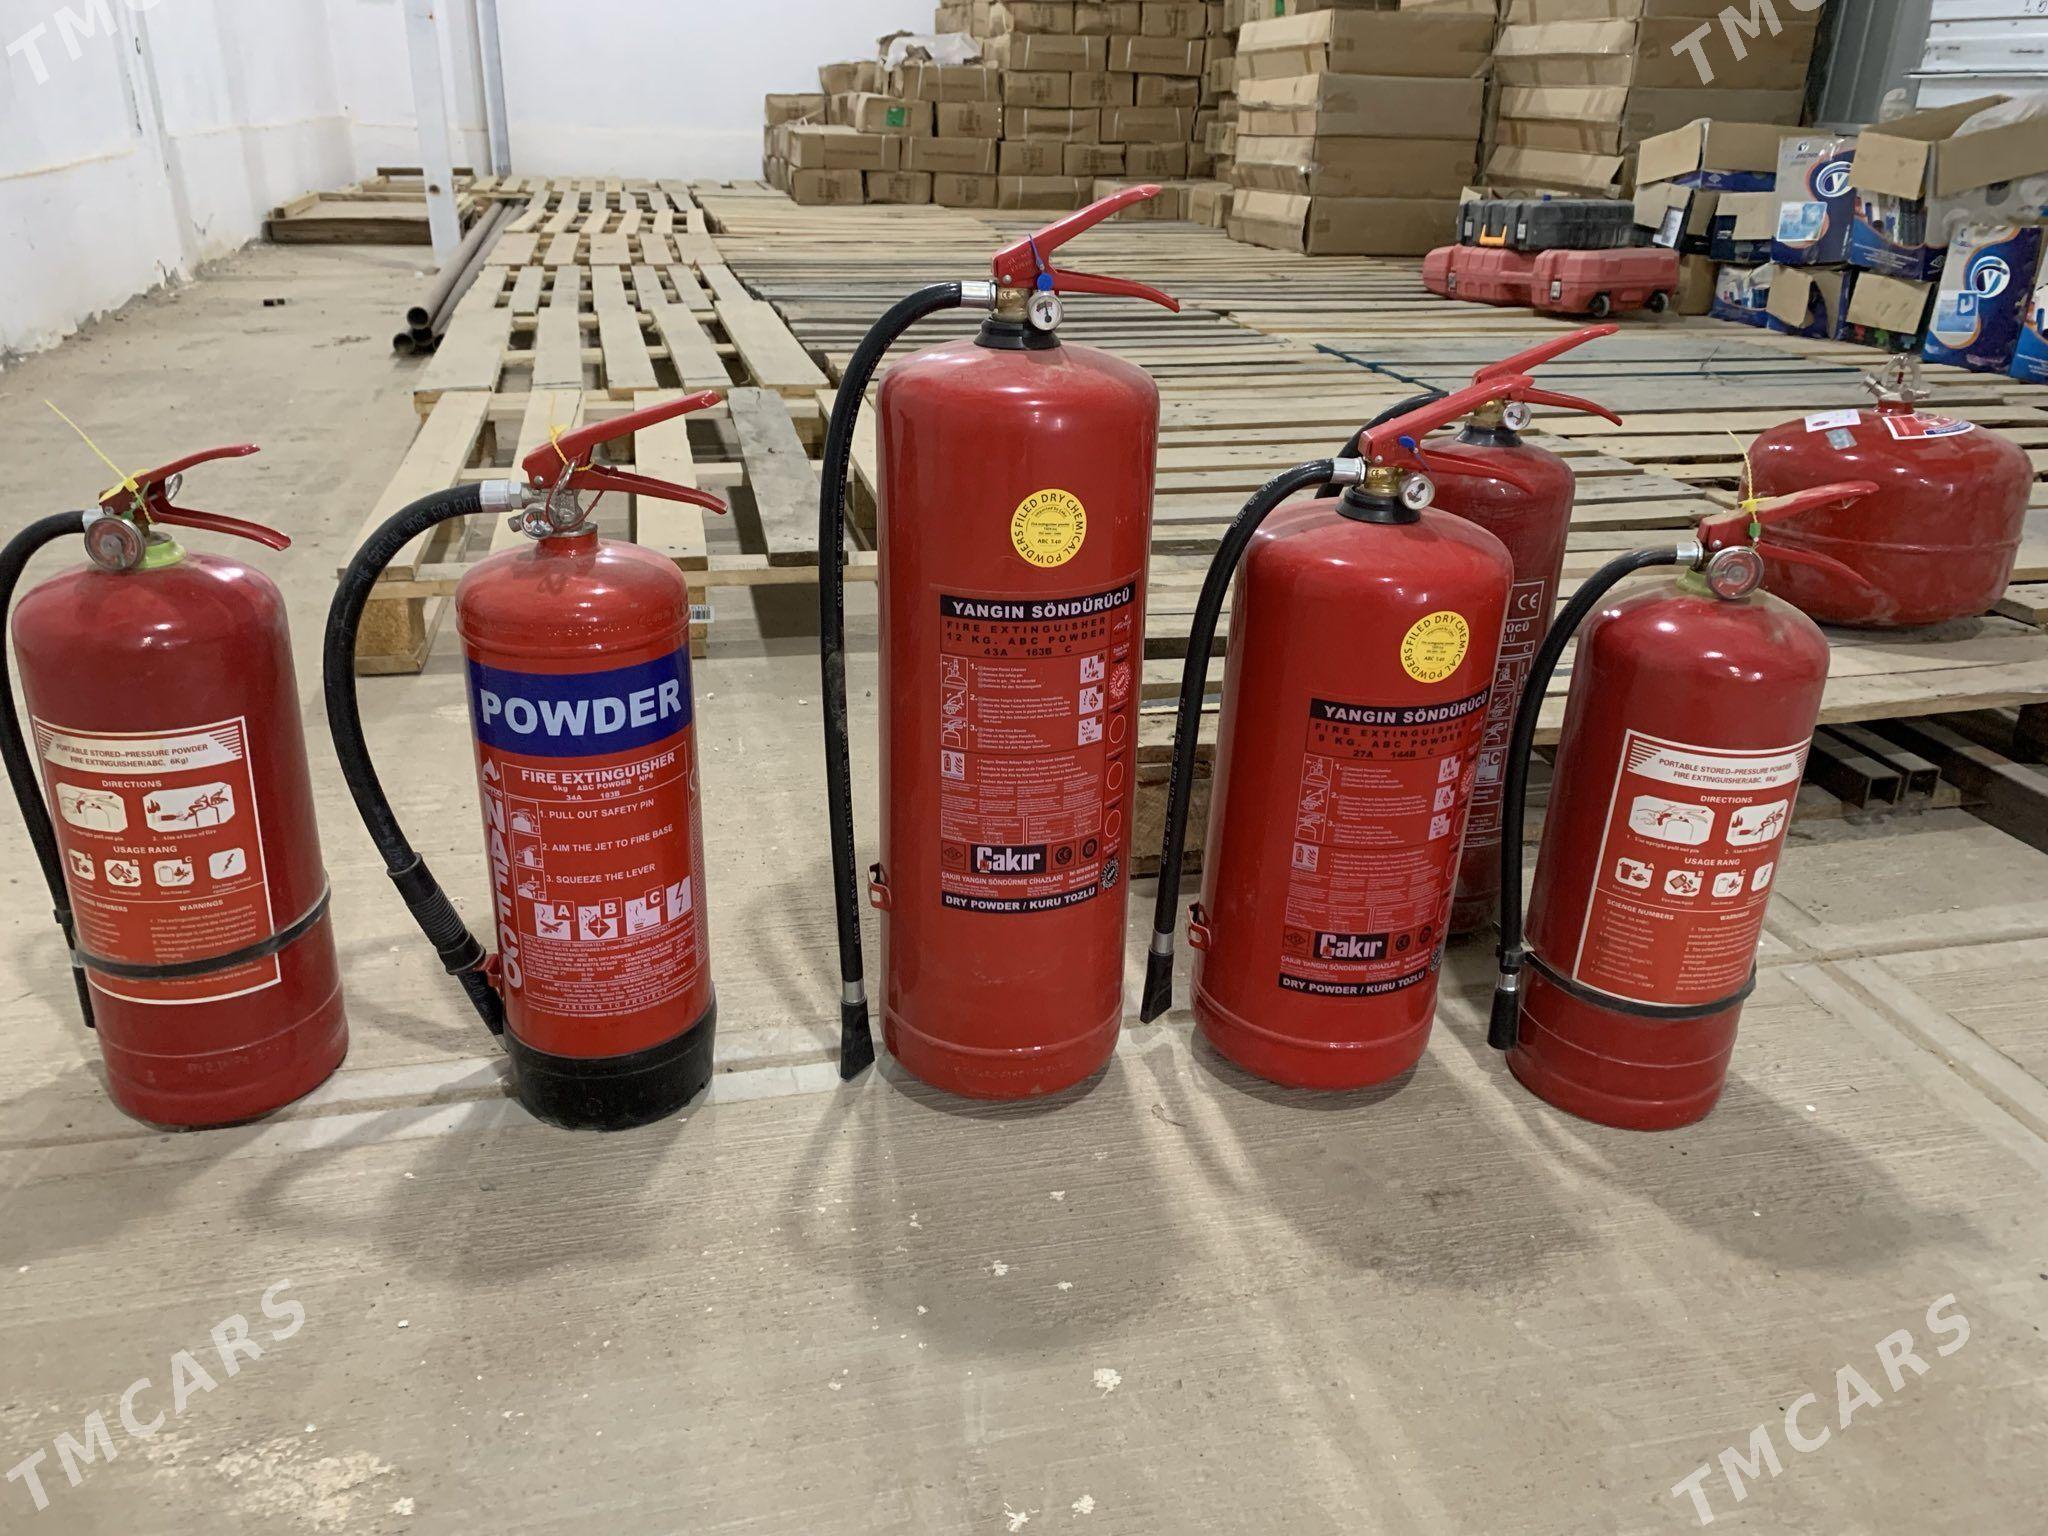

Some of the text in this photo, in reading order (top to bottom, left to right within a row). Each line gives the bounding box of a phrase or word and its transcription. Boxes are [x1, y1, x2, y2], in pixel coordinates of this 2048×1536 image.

[431, 501, 452, 520] FOR
[1041, 493, 1065, 503] DRY
[1063, 500, 1083, 554] CHEMICAL
[952, 587, 1130, 619] YANGIN SÖNDÜRÜCÜ
[947, 621, 980, 632] FIRE
[990, 616, 1106, 634] EXTINGUISHER
[1435, 614, 1456, 624] DRY
[946, 633, 962, 641] 12
[1008, 636, 1039, 646] ABC
[1049, 628, 1105, 644] POWDER
[1445, 620, 1467, 671] CHEMICAL
[480, 678, 682, 737] POWDER
[1323, 691, 1488, 724] YANGIN SÖNDÜRÜCÜ
[1315, 719, 1468, 738] FIRE EXTINGUISHER
[1372, 739, 1400, 749] ABC
[1411, 731, 1463, 747] POWDER
[56, 743, 88, 756] PORTABLE
[171, 744, 208, 756] POWDER
[521, 752, 675, 784] FIRE EXTINGUISHER
[1659, 758, 1698, 773] PORTABLE
[101, 779, 162, 789] DIRECTIONS
[597, 779, 632, 789] POWDER
[1673, 771, 1691, 781] FIRE
[1700, 795, 1753, 804] DIRECTIONS
[540, 799, 654, 819] 1. PULL OUT SAFETY PIN
[552, 844, 570, 852] AIM
[572, 844, 592, 852] THE
[595, 841, 613, 851] JET
[615, 839, 628, 848] TO
[631, 833, 650, 845] FIRE
[653, 823, 673, 839] BASE
[113, 845, 177, 854] USAGE RANG
[1684, 857, 1715, 866] USAGE
[556, 874, 602, 884] SQUEEZE
[604, 871, 623, 881] THE
[626, 864, 656, 878] LEVER
[961, 876, 987, 884] YANGIN
[484, 793, 522, 989] NAFFCO
[649, 891, 660, 903] C
[945, 895, 967, 907] DRY
[970, 900, 1020, 910] POWDER
[1029, 898, 1061, 909] KURU
[1064, 887, 1095, 903] TOZLU
[179, 900, 223, 911] WARNINGS
[557, 905, 570, 917] A
[605, 902, 617, 915] B
[1637, 908, 1674, 921] NUMBERS
[1302, 959, 1328, 970] YANGIN
[1282, 977, 1305, 992] DRY
[1309, 983, 1358, 994] POWDER
[1366, 983, 1396, 994] KURU
[1398, 971, 1425, 987] TOZLU
[626, 988, 667, 1005] PROTECT
